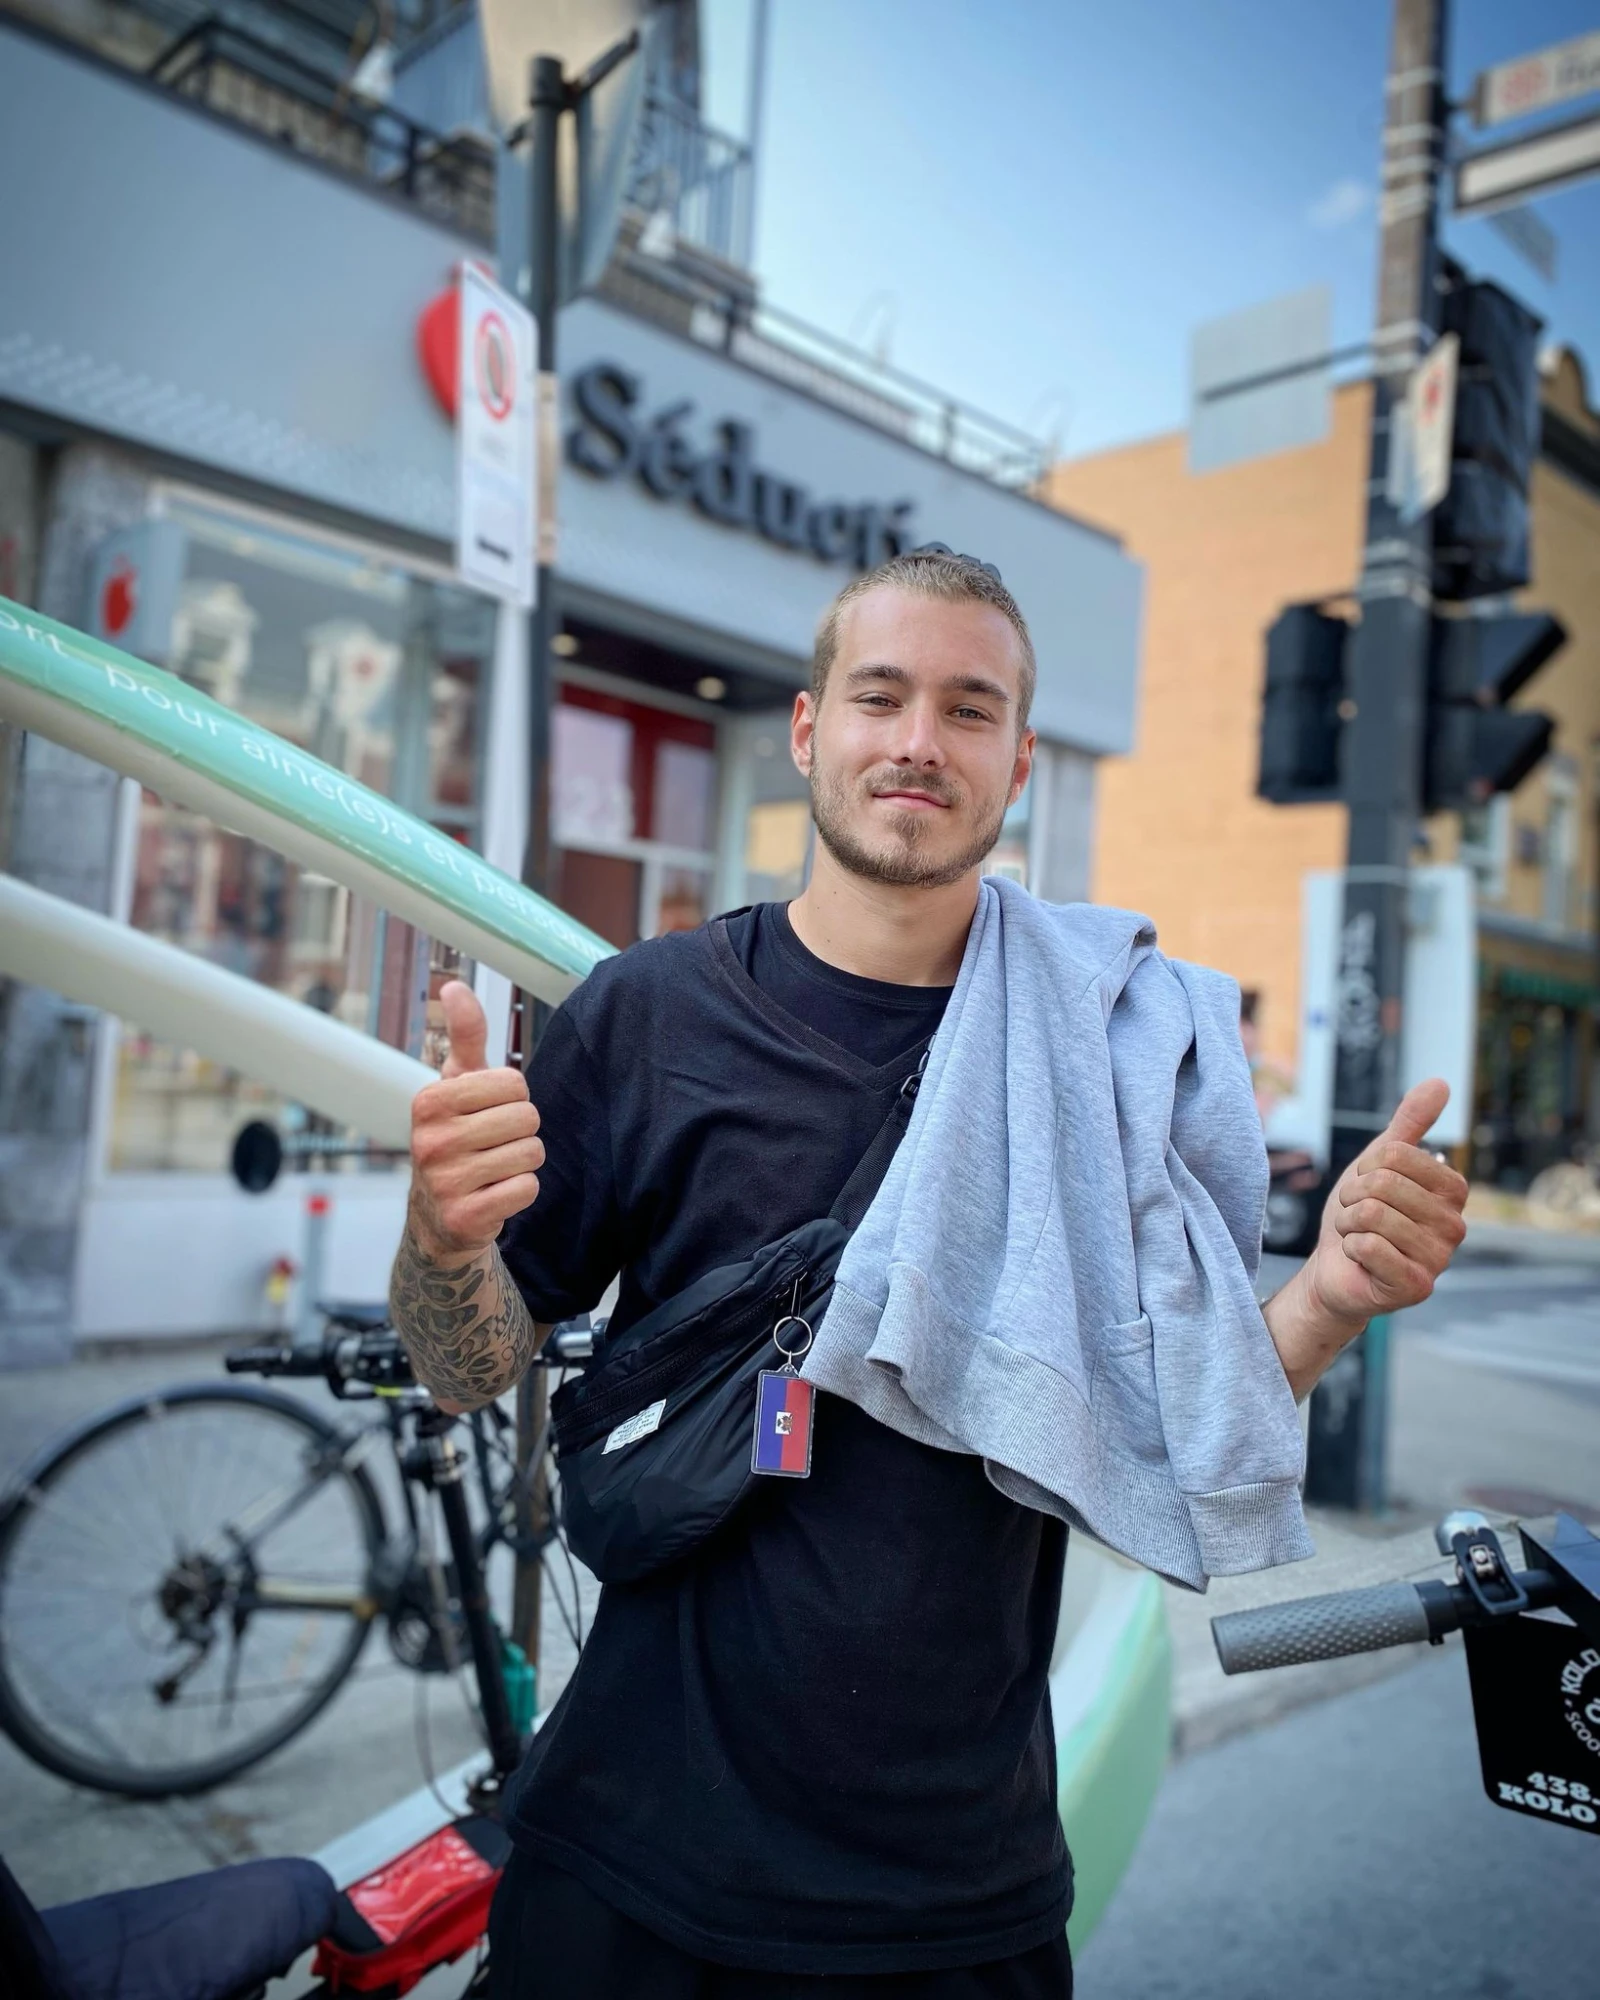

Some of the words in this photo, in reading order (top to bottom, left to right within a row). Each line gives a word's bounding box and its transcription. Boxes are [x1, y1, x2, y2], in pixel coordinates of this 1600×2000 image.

[105, 664, 223, 737] pour
[424, 839, 463, 878] et
[1560, 1648, 1600, 1695] KOLO
[1564, 1711, 1600, 1757] SCOO
[1498, 1781, 1597, 1824] KOLO
